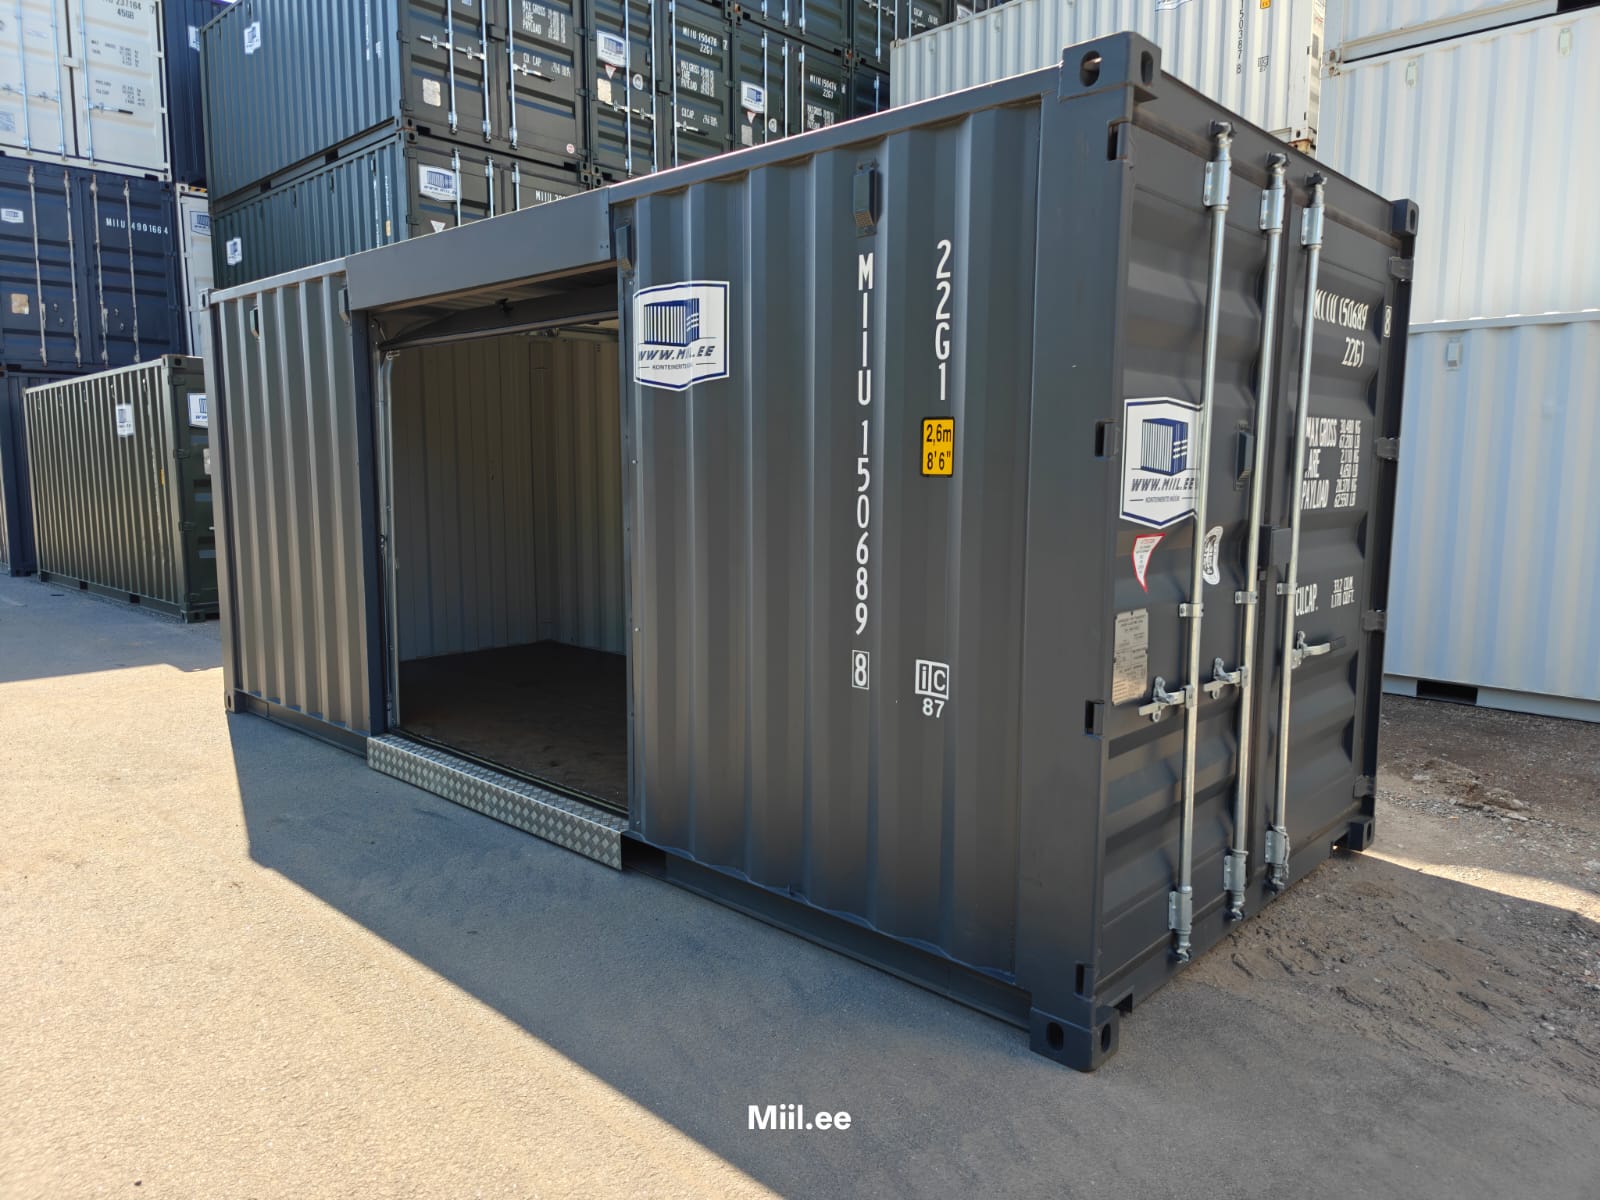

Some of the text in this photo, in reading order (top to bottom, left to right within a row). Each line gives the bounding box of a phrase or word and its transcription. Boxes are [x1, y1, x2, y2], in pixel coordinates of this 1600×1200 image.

[105, 217, 126, 229] MIIU
[164, 226, 169, 234] 4
[934, 239, 952, 401] 22G1
[1313, 289, 1392, 335] MIIU 150689 8
[1341, 337, 1365, 368] 22G1
[926, 423, 951, 446] 2,6m
[1319, 417, 1338, 447] GROSS
[854, 252, 874, 687] MIIU 150689 8
[1304, 448, 1321, 478] ARE
[1131, 478, 1194, 493] WWW.MIIL.EE
[1300, 479, 1330, 510] PAYLOAD
[922, 697, 945, 718] 87
